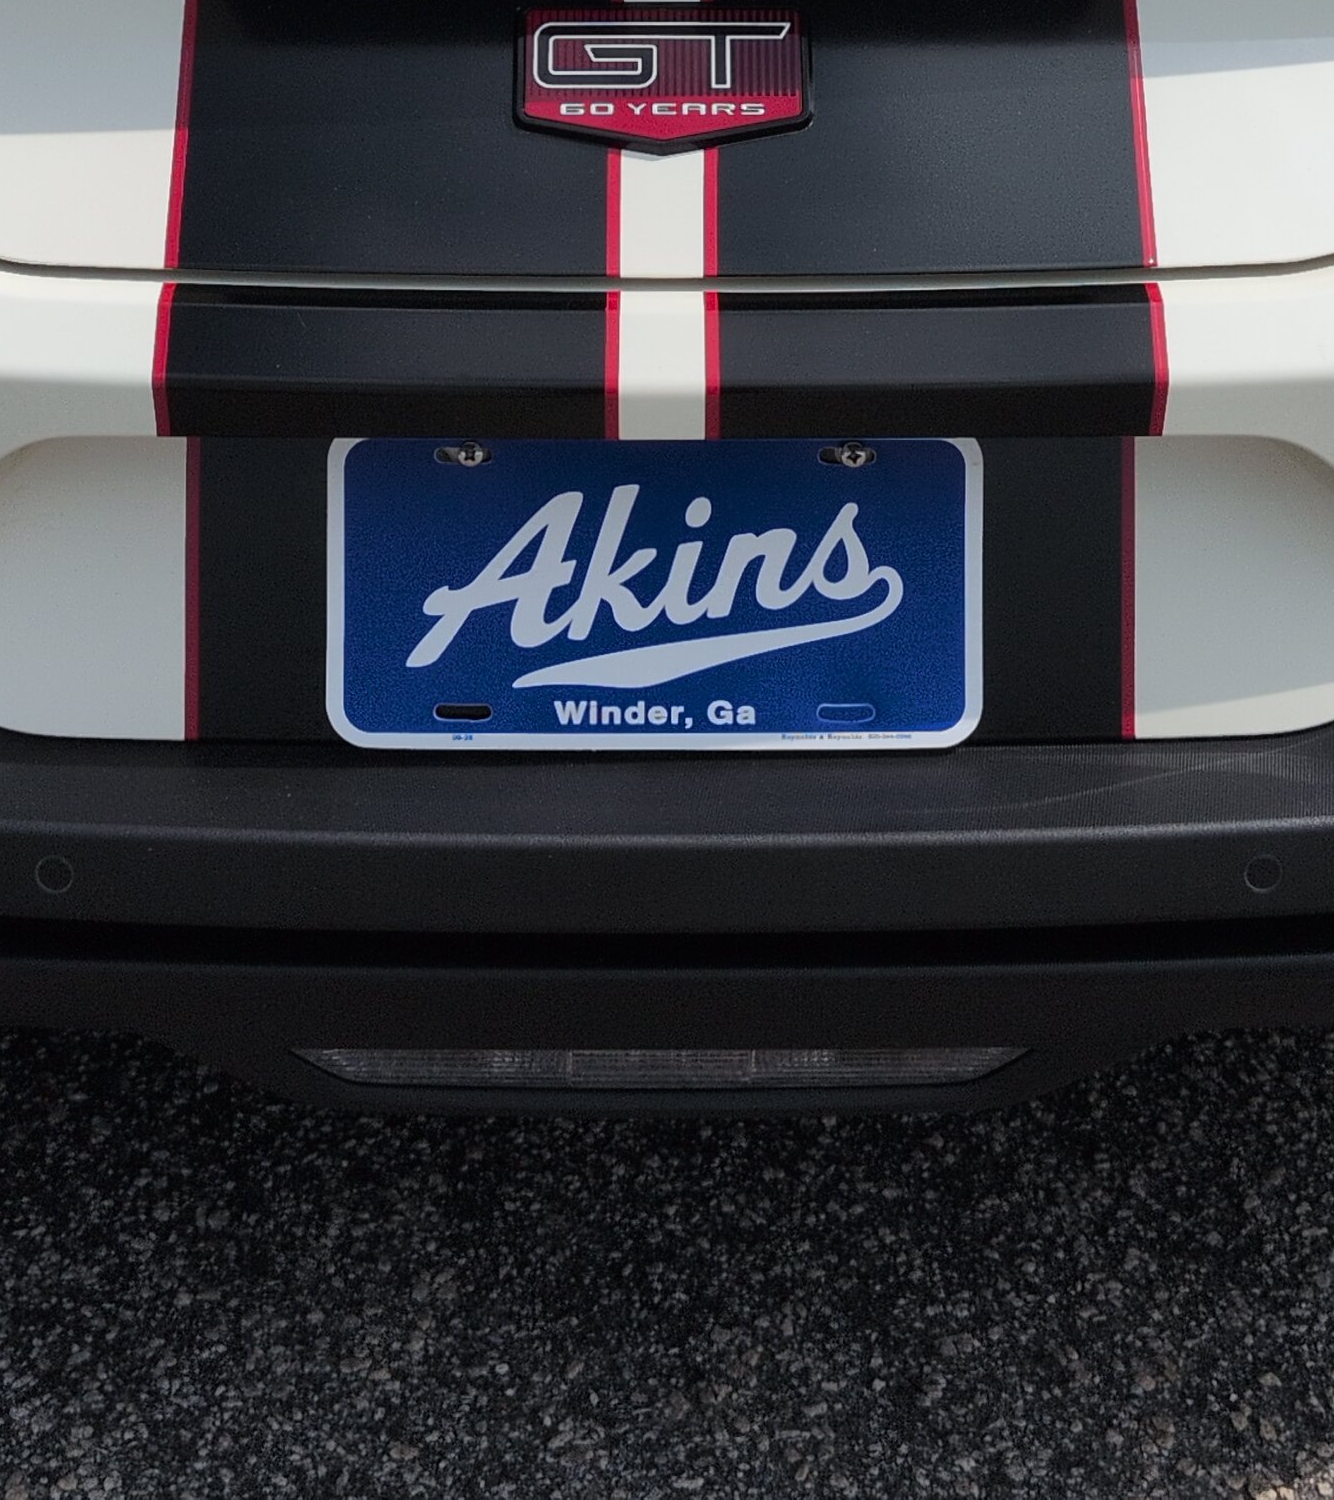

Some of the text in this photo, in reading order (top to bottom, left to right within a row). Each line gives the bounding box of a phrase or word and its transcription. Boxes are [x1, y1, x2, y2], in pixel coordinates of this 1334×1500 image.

[533, 21, 791, 89] GT
[560, 102, 766, 116] 60 YEARS
[406, 484, 904, 688] Akins
[554, 699, 756, 729] Winder, Ga
